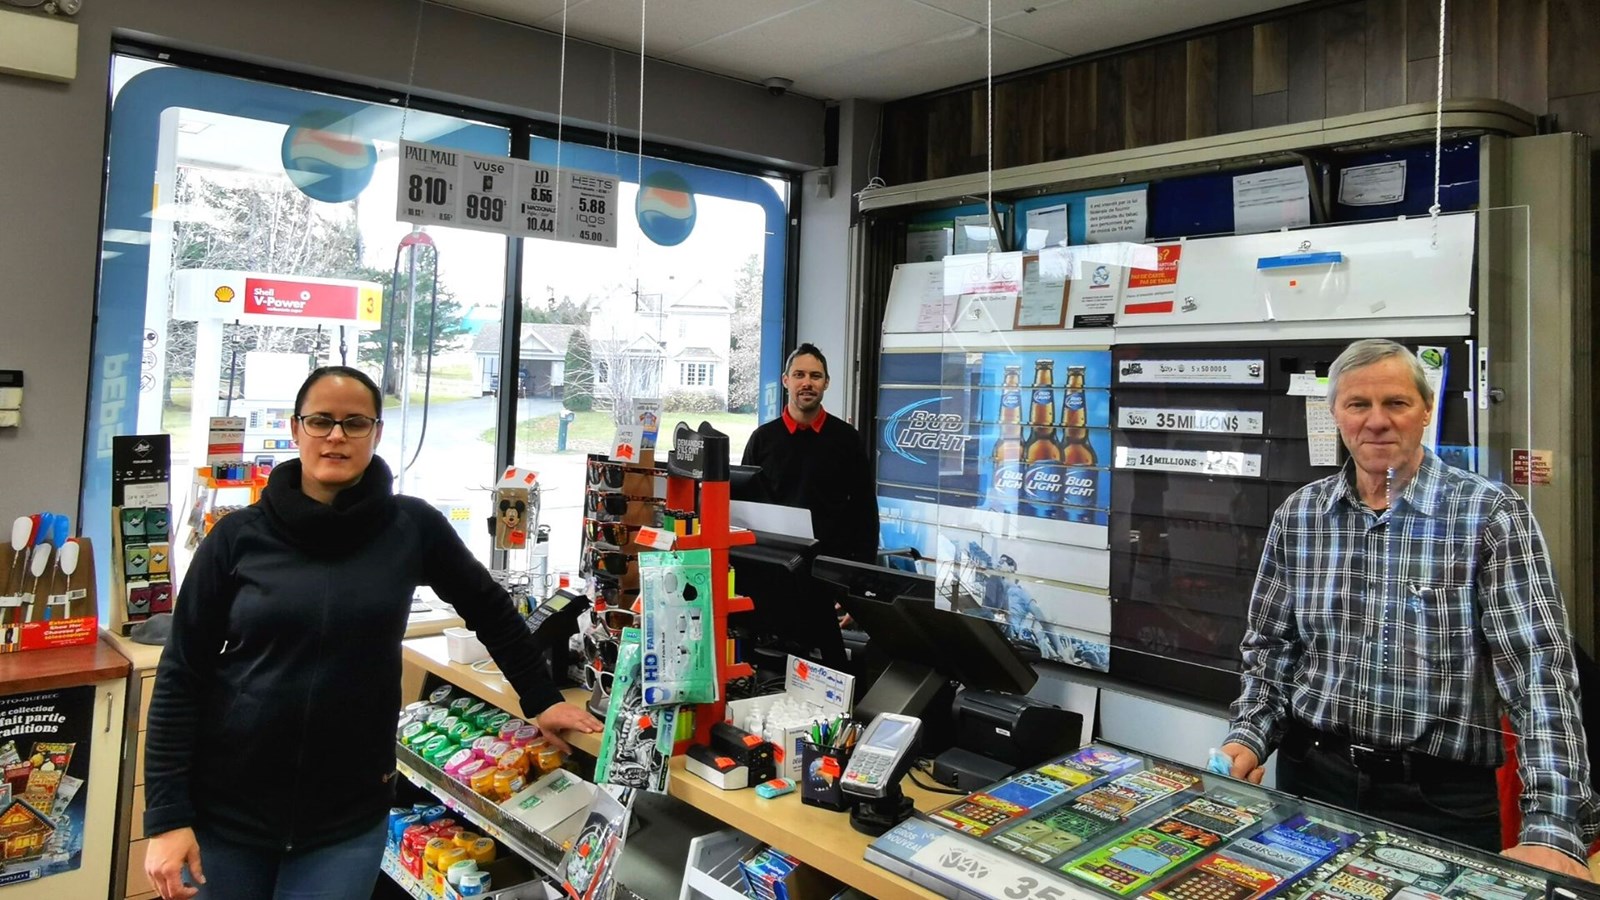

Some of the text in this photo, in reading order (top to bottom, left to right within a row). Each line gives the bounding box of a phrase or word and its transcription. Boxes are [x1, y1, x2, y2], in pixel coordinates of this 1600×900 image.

[405, 145, 457, 167] PALL MALL
[535, 170, 549, 184] LD
[408, 174, 447, 206] 810
[531, 187, 552, 203] 8.55
[466, 193, 504, 222] 999
[579, 197, 606, 215] 5.88
[527, 217, 554, 233] 10.44
[576, 213, 606, 225] IQOS
[579, 230, 603, 242] 45.00
[254, 287, 274, 297] Shell
[254, 295, 375, 314] V-Power 3
[909, 410, 964, 432] BUD
[1156, 413, 1176, 428] 35
[677, 439, 704, 449] DEMANDEZ
[896, 429, 973, 451] LIGHT
[1140, 454, 1153, 466] 14
[1154, 457, 1197, 467] MILLIONS
[1034, 471, 1061, 483] BUD
[1065, 477, 1093, 488] BUD
[1027, 480, 1062, 492] LIGHT
[1065, 486, 1095, 497] IGHT
[644, 654, 658, 681] HD
[8, 705, 55, 715] collection
[25, 713, 67, 725] partie
[0, 723, 59, 738] raditions
[1241, 840, 1298, 863] CHROME
